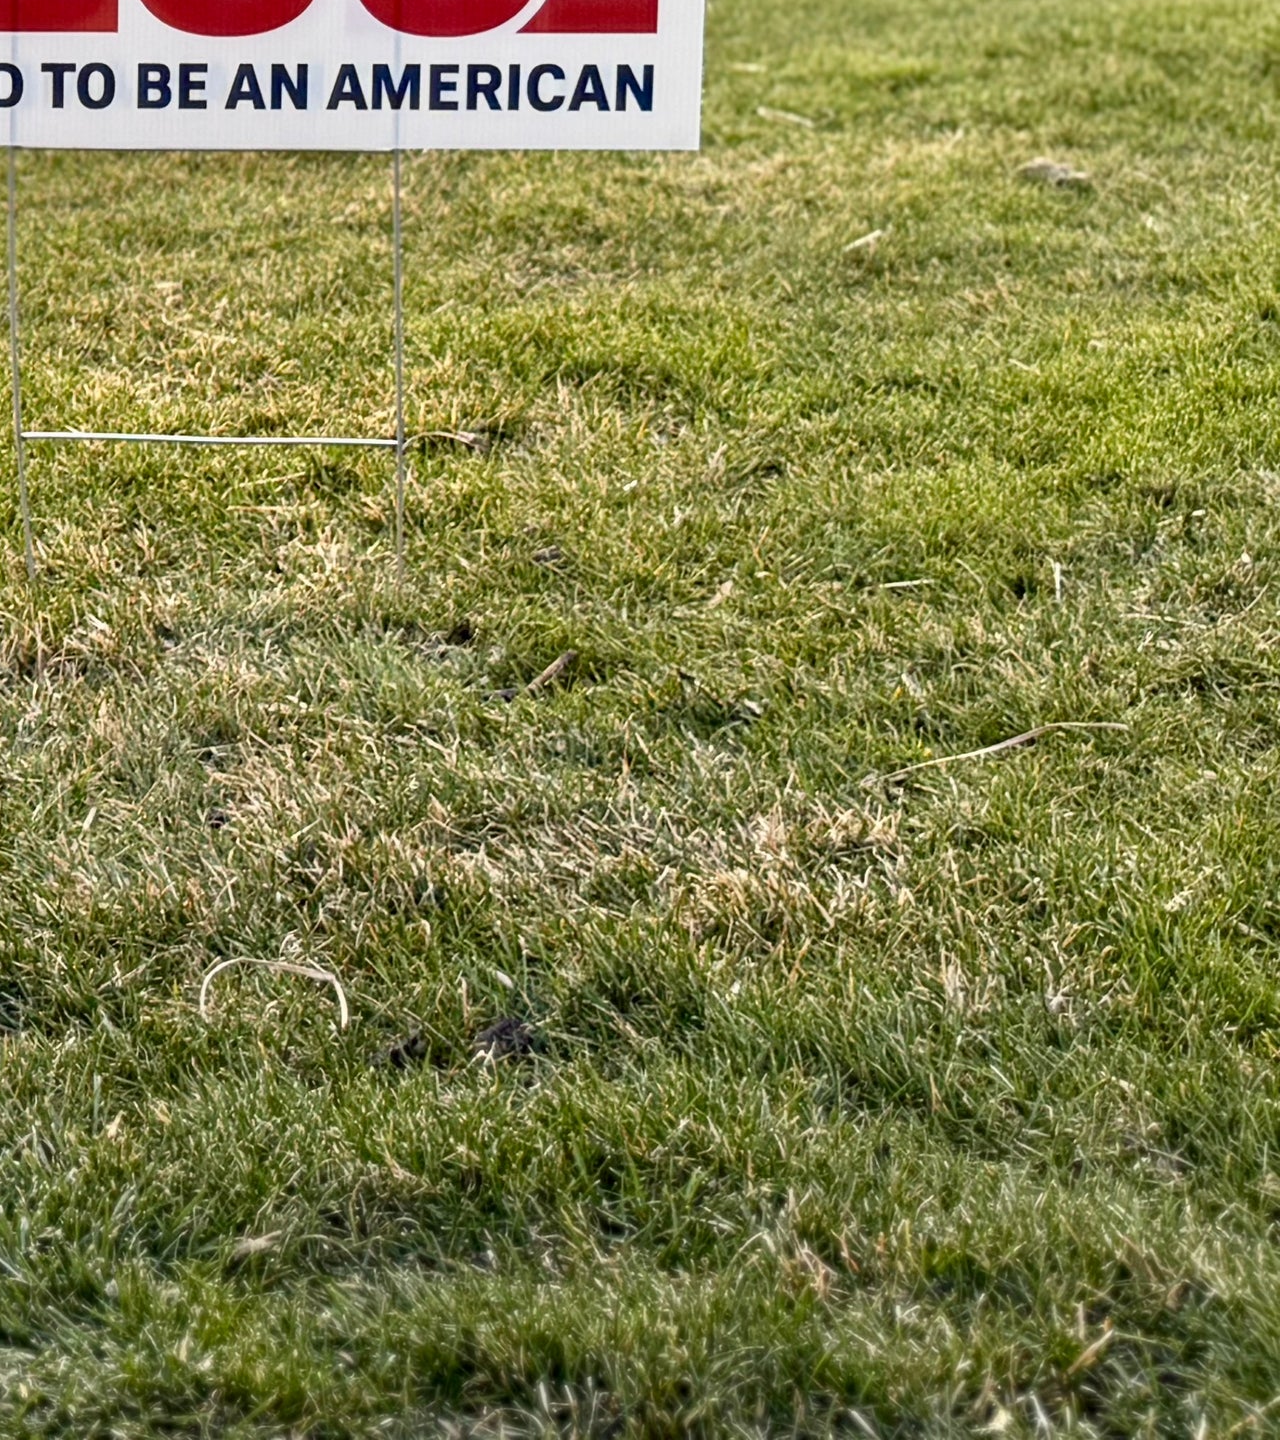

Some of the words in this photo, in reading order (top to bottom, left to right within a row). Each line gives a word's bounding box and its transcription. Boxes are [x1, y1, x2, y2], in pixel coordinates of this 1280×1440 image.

[41, 62, 116, 110] TO
[137, 62, 208, 110] BE
[224, 62, 309, 111] AN
[326, 62, 656, 112] AMERICAN
